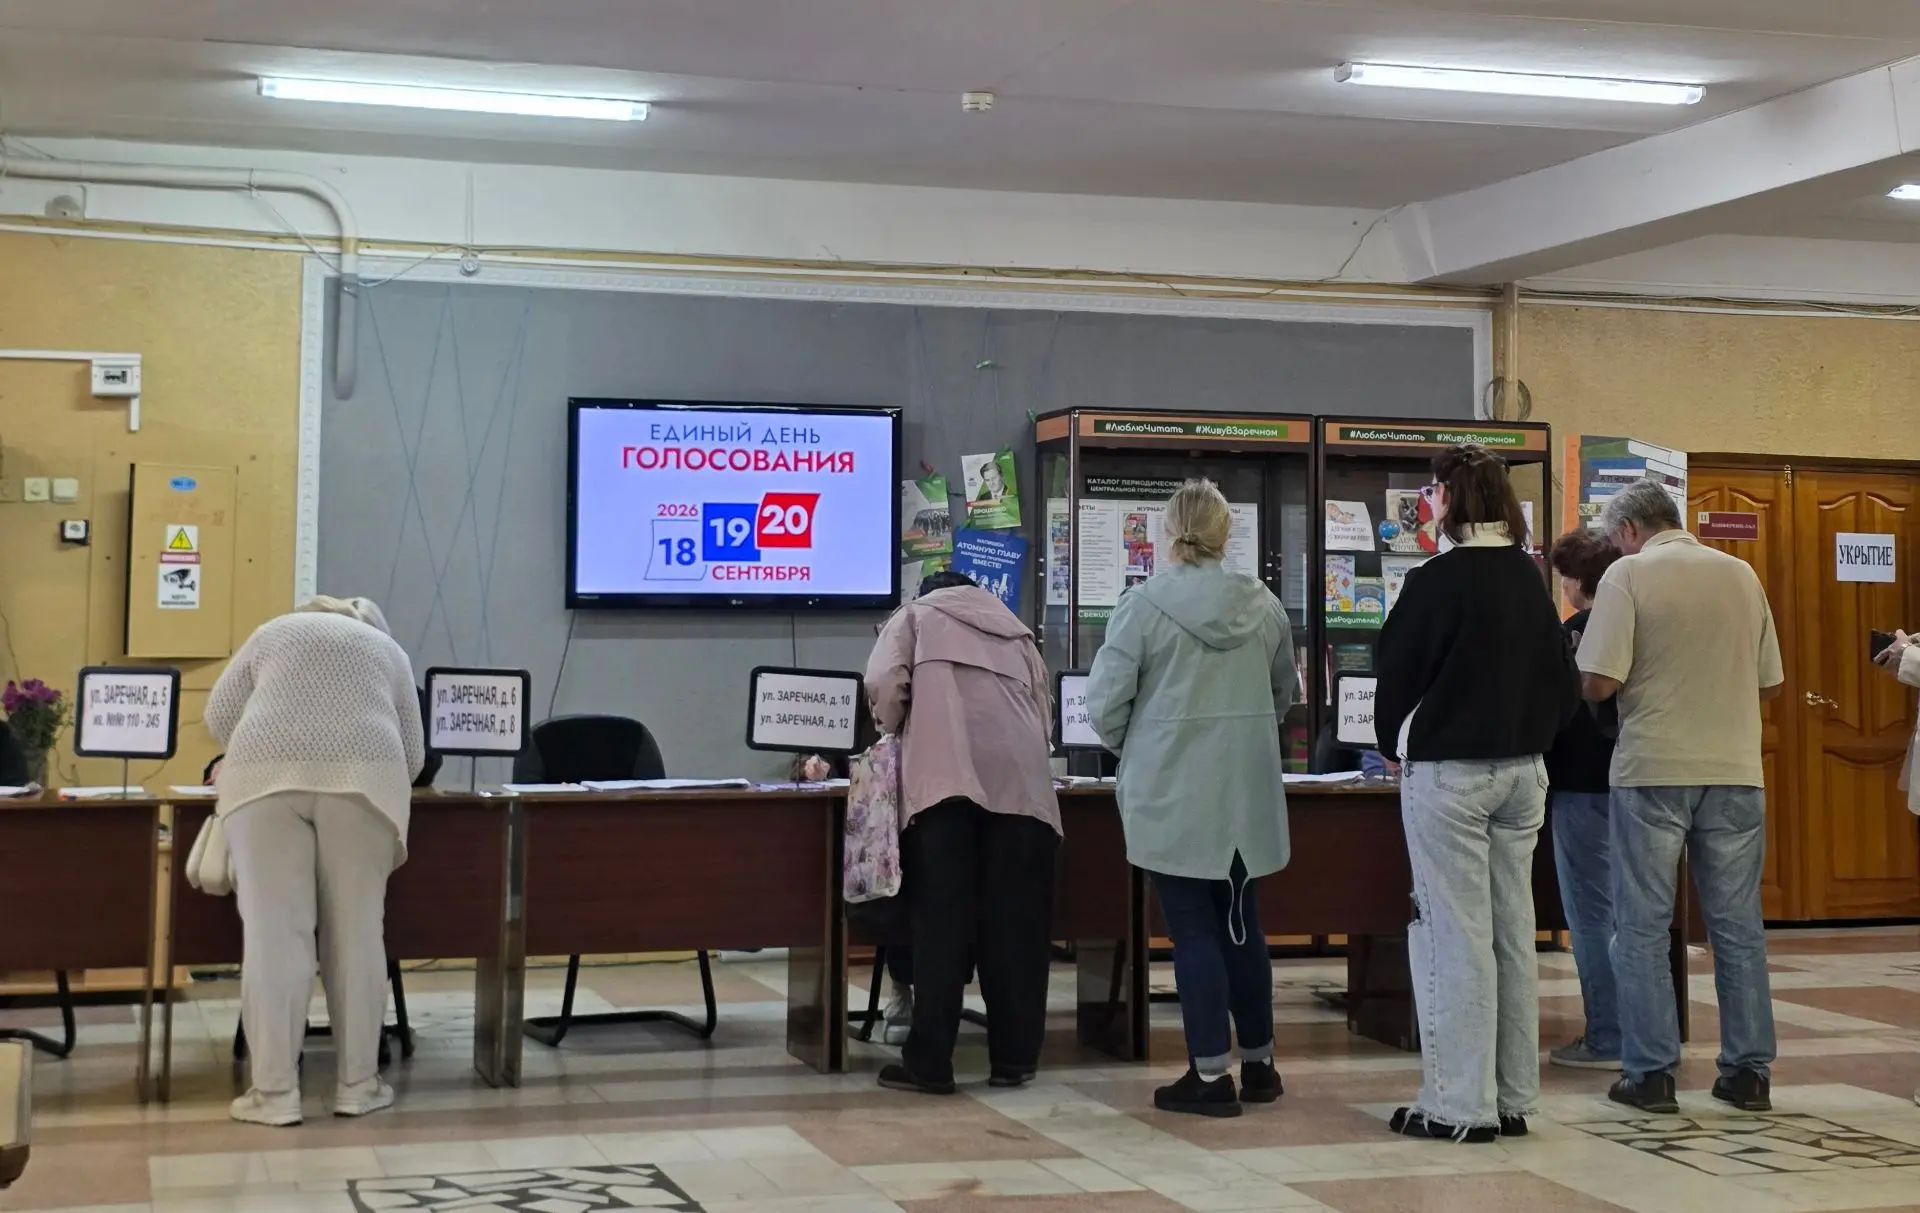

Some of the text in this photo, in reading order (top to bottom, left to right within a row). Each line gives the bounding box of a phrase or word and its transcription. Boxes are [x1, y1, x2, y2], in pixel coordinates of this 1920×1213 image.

[650, 423, 820, 445] ЕДИНЫЙ ДЕНЬ
[1105, 423, 1278, 437] #ЛюблюЧитать #ЖивуВЗаречном
[1350, 430, 1516, 444] #ЛюблюЧитать #ЖивуВЗаречном
[623, 447, 854, 473] ГОЛОСОВАНИЯ
[657, 504, 698, 517] 2026
[658, 504, 808, 566] 18 19 20
[957, 541, 996, 555] АТОМНУЮ
[997, 549, 1021, 559] ГЛАВУ
[1839, 545, 1893, 566] УКРЫТИЕ
[712, 565, 810, 581] СЕНТЯБРЯ
[1325, 616, 1380, 624] ДляРодителей
[90, 689, 102, 708] ул.
[161, 686, 167, 706] 5
[437, 684, 516, 708] ул. ЗАРЕЧНАЯ, д. 6
[762, 690, 850, 706] ул. ЗАРЕЧНАЯ, д. 10
[1344, 691, 1356, 702] ул.
[436, 711, 516, 736] ул. ЗАРЕЧНАЯ, д. 8
[760, 714, 773, 726] ул.
[828, 719, 837, 730] д.
[839, 718, 849, 729] 12
[1344, 714, 1356, 725] ул.
